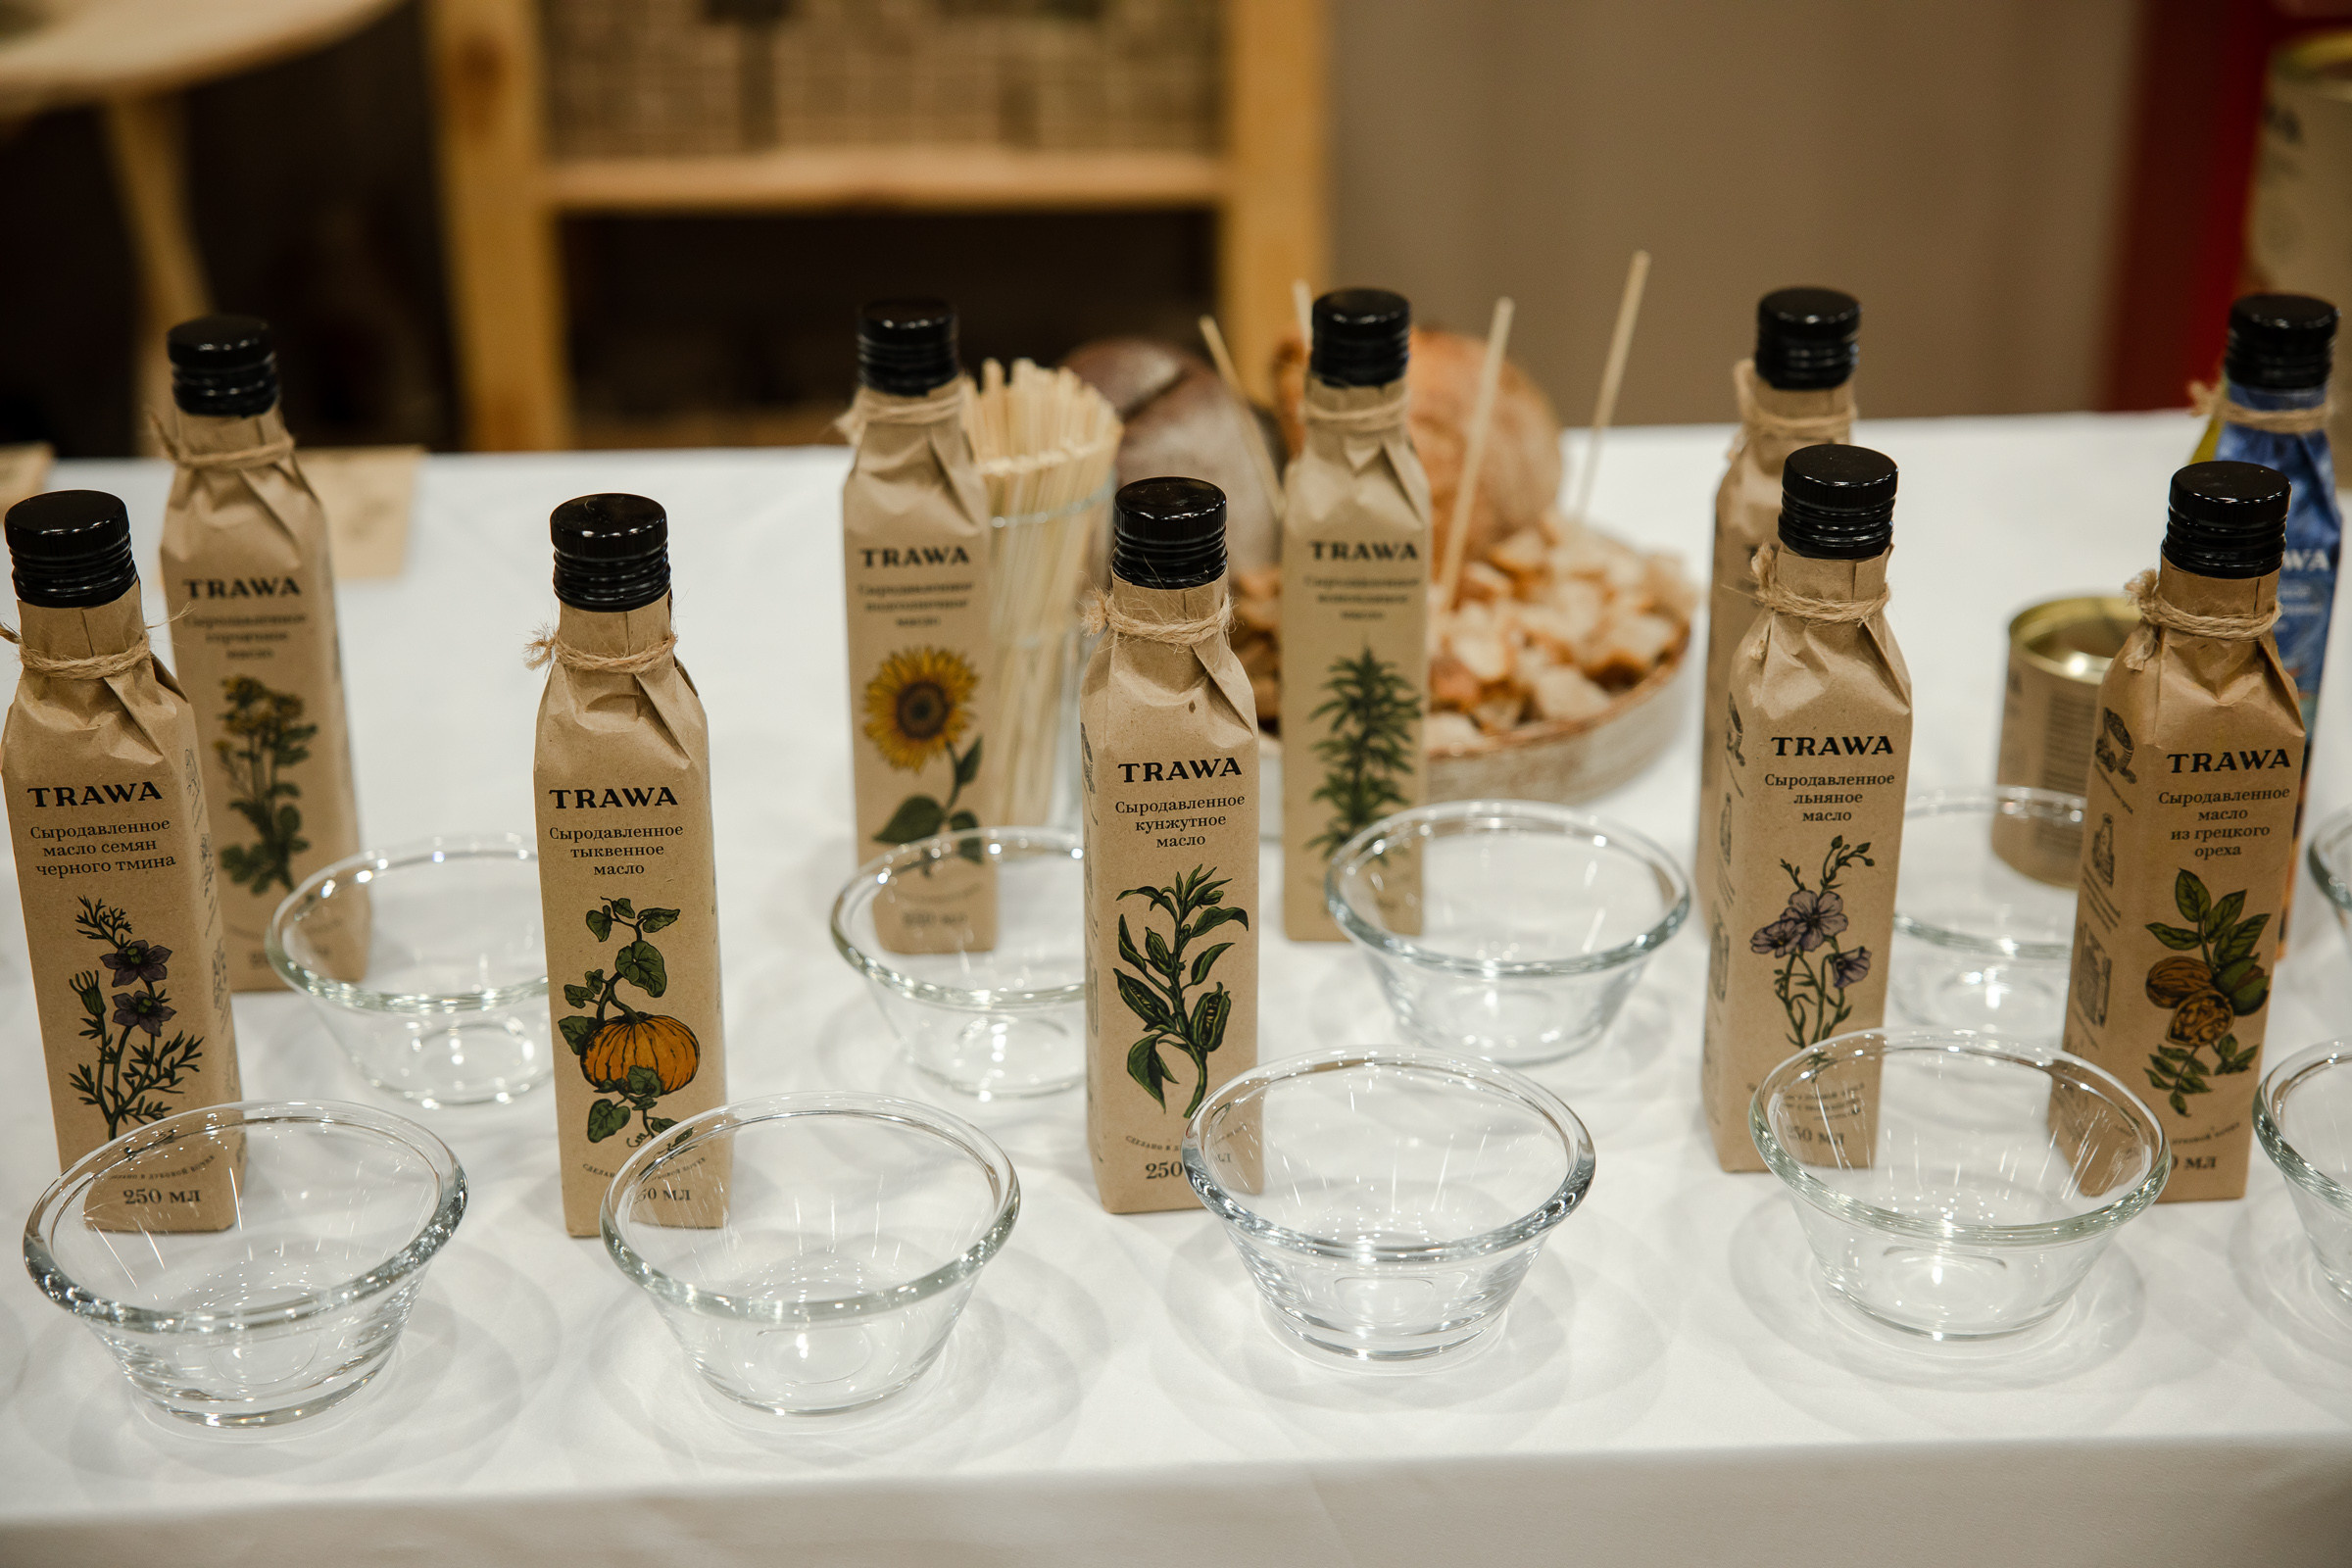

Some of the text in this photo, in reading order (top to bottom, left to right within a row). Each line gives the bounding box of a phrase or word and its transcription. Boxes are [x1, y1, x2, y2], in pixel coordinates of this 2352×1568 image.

[859, 546, 970, 568] TRAWA
[1309, 541, 1418, 562] TRAWA
[182, 576, 301, 600] TRAWA
[1770, 735, 1893, 756] TRAWA
[1117, 757, 1243, 783] TRAWA
[2166, 749, 2291, 773] TRAWA
[1764, 773, 1895, 790] Сыродавленное
[26, 781, 163, 808] TRAWA
[549, 787, 678, 809] TRAWA
[1793, 793, 1863, 805] льняное
[2158, 788, 2290, 808] Сыродавленное
[1115, 795, 1246, 816] Сыродавленное
[2197, 808, 2248, 821] масло
[1135, 815, 1226, 834] кунжутное
[1802, 810, 1852, 822] масло
[30, 819, 171, 842] Сыродавленное
[549, 825, 684, 843] Сыродавленное
[2170, 826, 2271, 842] из грецкого
[43, 840, 158, 858] масло семян
[1156, 835, 1205, 849] масло
[570, 846, 664, 858] тыквенное
[2194, 845, 2242, 860] ореха
[35, 856, 176, 879] черного тмина
[593, 864, 645, 875] масло
[1146, 1160, 1184, 1180] 250
[122, 1188, 162, 1204] 250
